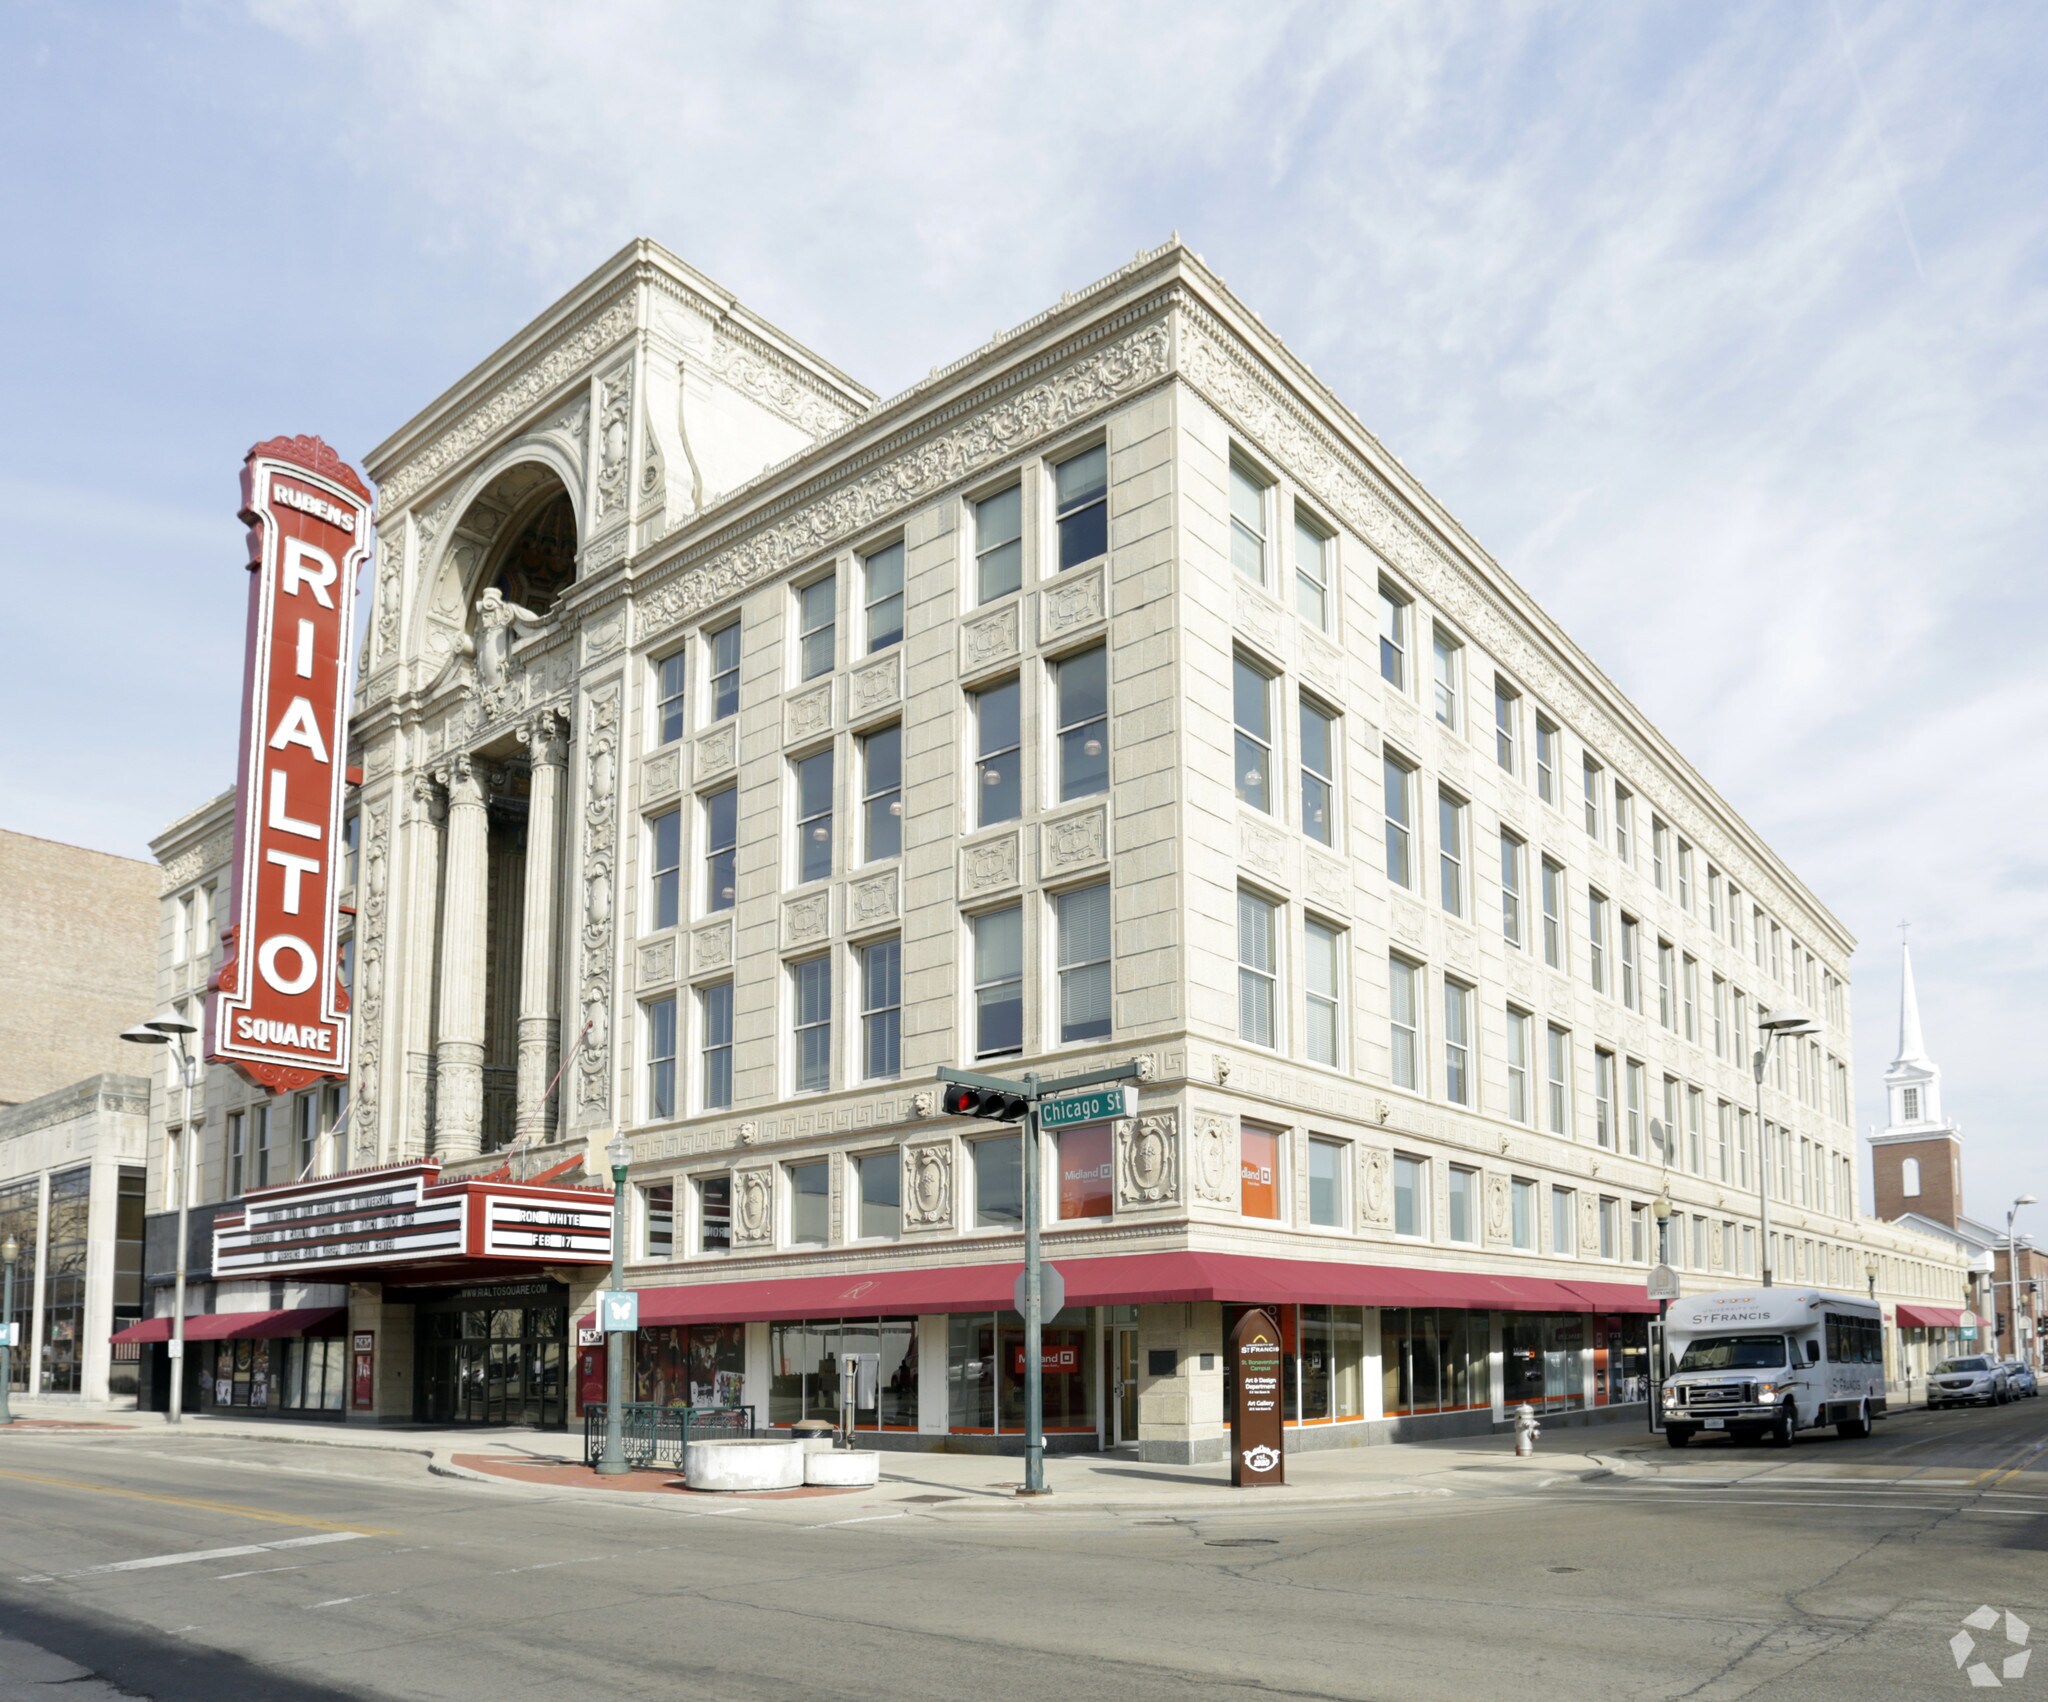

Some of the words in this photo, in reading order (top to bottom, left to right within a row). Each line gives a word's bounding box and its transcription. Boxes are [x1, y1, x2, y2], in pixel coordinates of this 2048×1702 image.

[273, 483, 354, 532] RUBENS
[258, 535, 338, 995] RIALTO
[236, 1015, 331, 1052] SQUARE
[1043, 1099, 1100, 1122] Chicago
[1107, 1092, 1122, 1110] St
[1065, 1167, 1099, 1181] Midland
[355, 1193, 393, 1211] ANNIVERSARY
[402, 1213, 414, 1226] GMC
[519, 1210, 539, 1223] RON
[549, 1211, 580, 1226] WHITE
[346, 1241, 369, 1255] MEDICAL
[373, 1239, 395, 1252] CENTER
[532, 1233, 551, 1246] FEB
[561, 1235, 572, 1248] 17
[461, 1283, 548, 1298] WWW.RIALTOSQUARE.COM
[1710, 1312, 1771, 1324] FRANCIS
[1018, 1354, 1059, 1364] Mand
